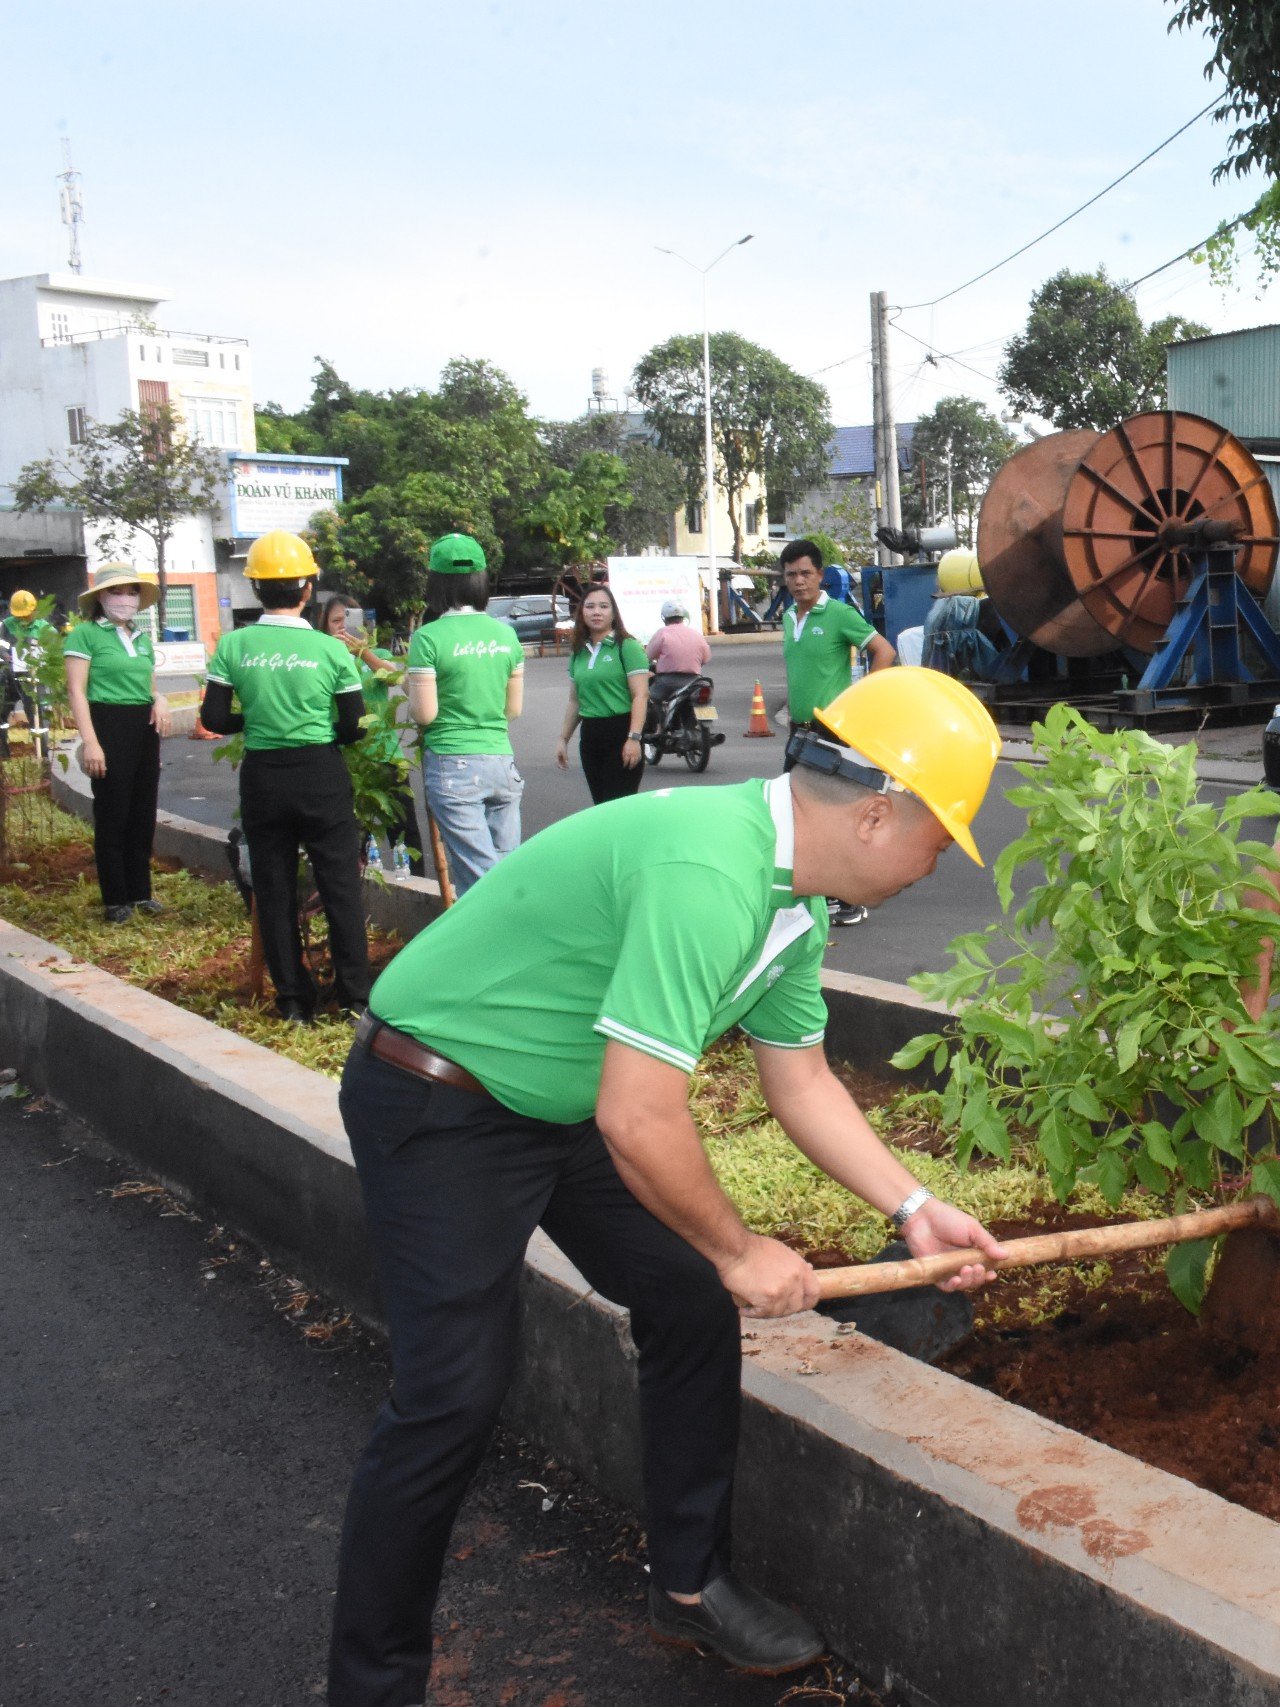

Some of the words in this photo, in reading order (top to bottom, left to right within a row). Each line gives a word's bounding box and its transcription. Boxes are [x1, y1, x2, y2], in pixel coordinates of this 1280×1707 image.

[237, 480, 271, 497] ĐOÀN
[241, 652, 267, 667] Let's
[269, 652, 284, 671] Go
[286, 653, 318, 671] Green
